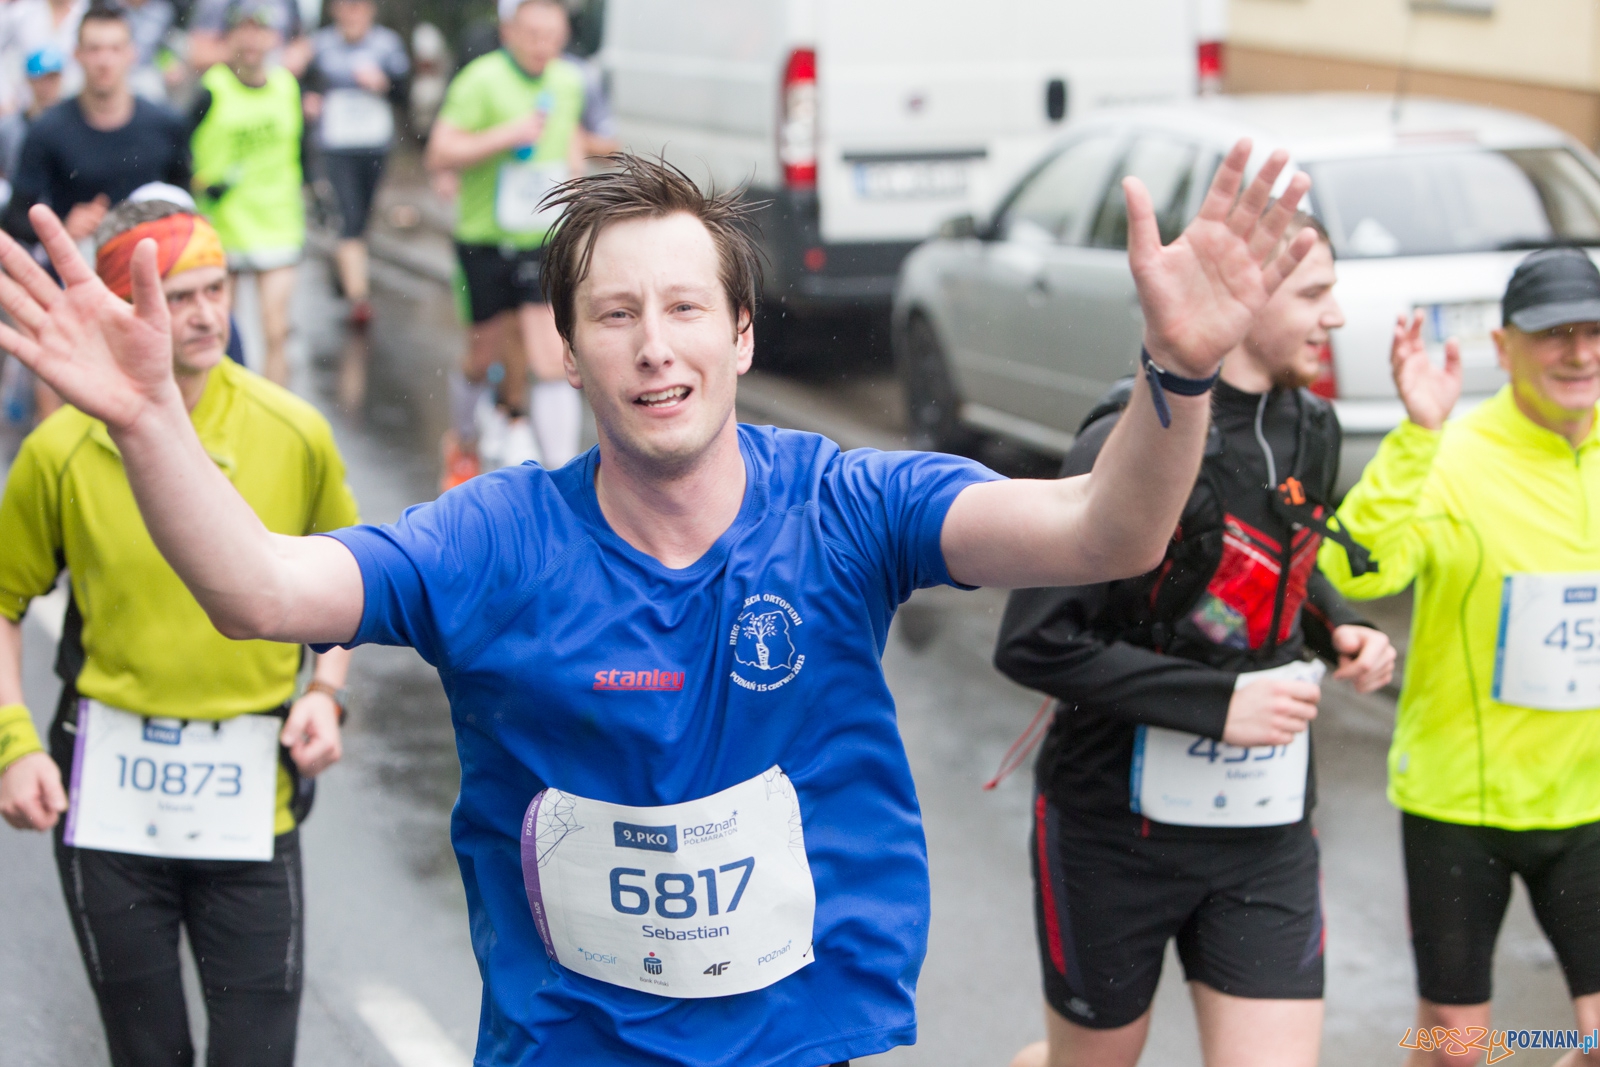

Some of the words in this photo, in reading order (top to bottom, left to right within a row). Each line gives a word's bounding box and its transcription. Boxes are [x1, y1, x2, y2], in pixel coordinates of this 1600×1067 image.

[729, 624, 740, 645] BIEG
[763, 594, 803, 626] ORTOPEDII
[1544, 619, 1600, 650] 45
[593, 668, 685, 690] stanley
[729, 671, 756, 691] POZNAŃ
[791, 654, 805, 675] 2013
[117, 754, 242, 797] 10873
[609, 856, 755, 919] 6817
[642, 925, 730, 941] Sebastian
[703, 961, 731, 976] 4F
